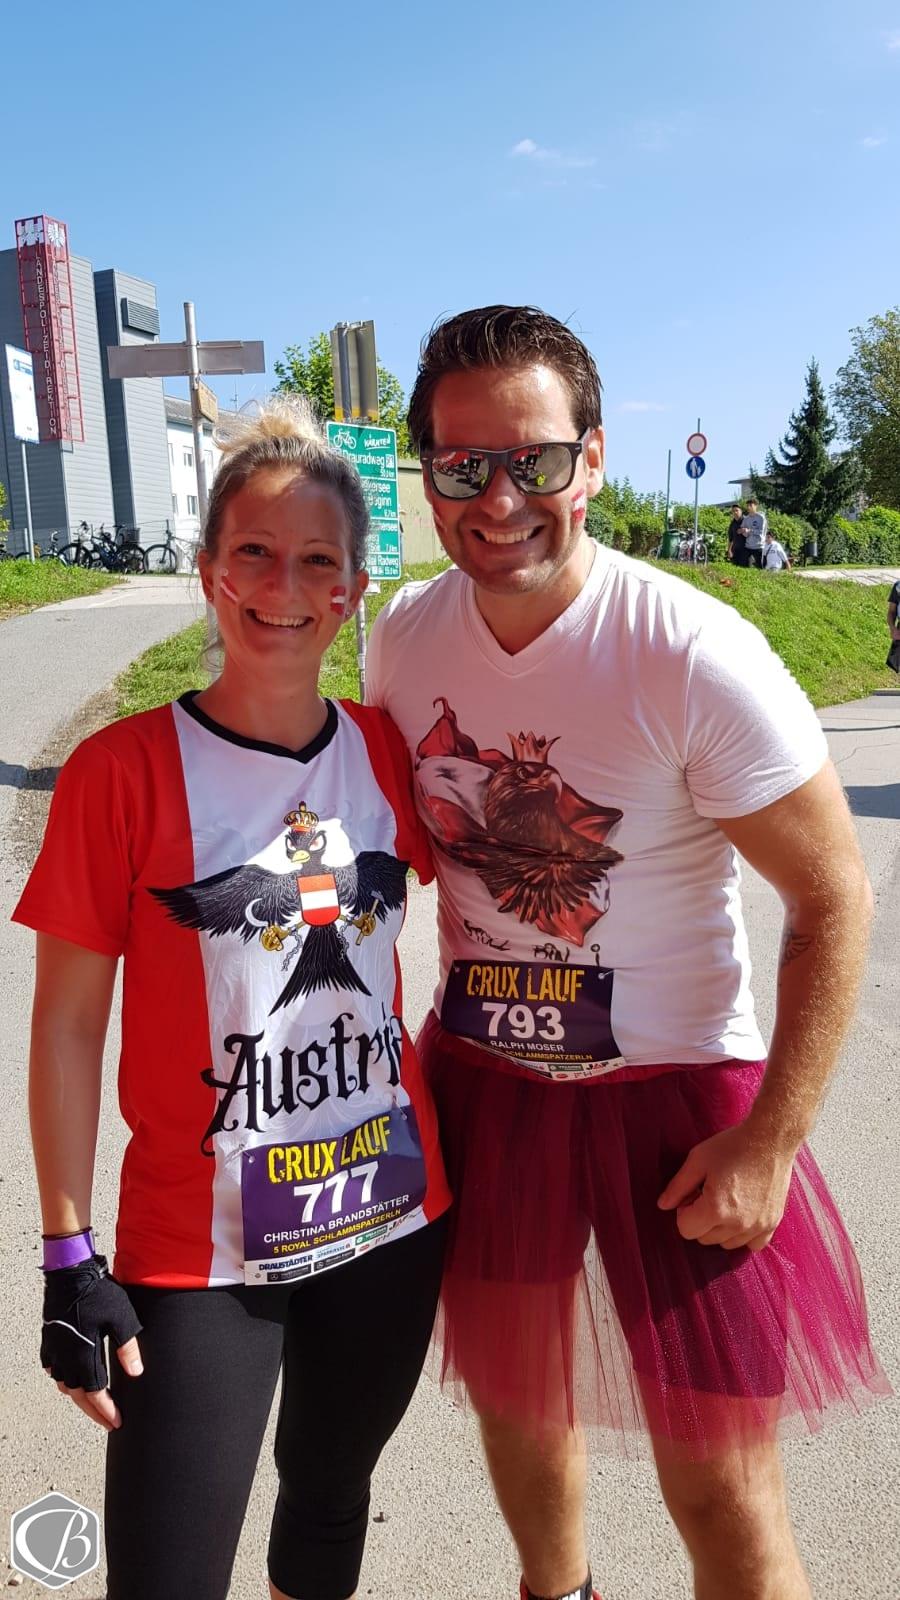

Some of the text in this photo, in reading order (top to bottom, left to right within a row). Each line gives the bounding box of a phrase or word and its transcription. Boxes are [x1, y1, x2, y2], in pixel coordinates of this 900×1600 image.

[36, 255, 57, 435] LANDESPOLIZEIDIREKTION
[342, 449, 385, 469] Drauradweg
[466, 964, 585, 1002] CRUX LAUF
[481, 1002, 565, 1041] 793
[490, 1041, 565, 1052] RALPH MOSER
[267, 1116, 392, 1184] CRUX LAUF
[293, 1160, 379, 1223] 777
[263, 1194, 410, 1244] CHRISTINA BRANDSTÄTTER
[273, 1246, 279, 1254] 5
[281, 1240, 311, 1254] ROYAL
[313, 1208, 401, 1245] SCHLAMMSPATZERLN
[258, 1255, 313, 1271] DRAUSTÄDTER
